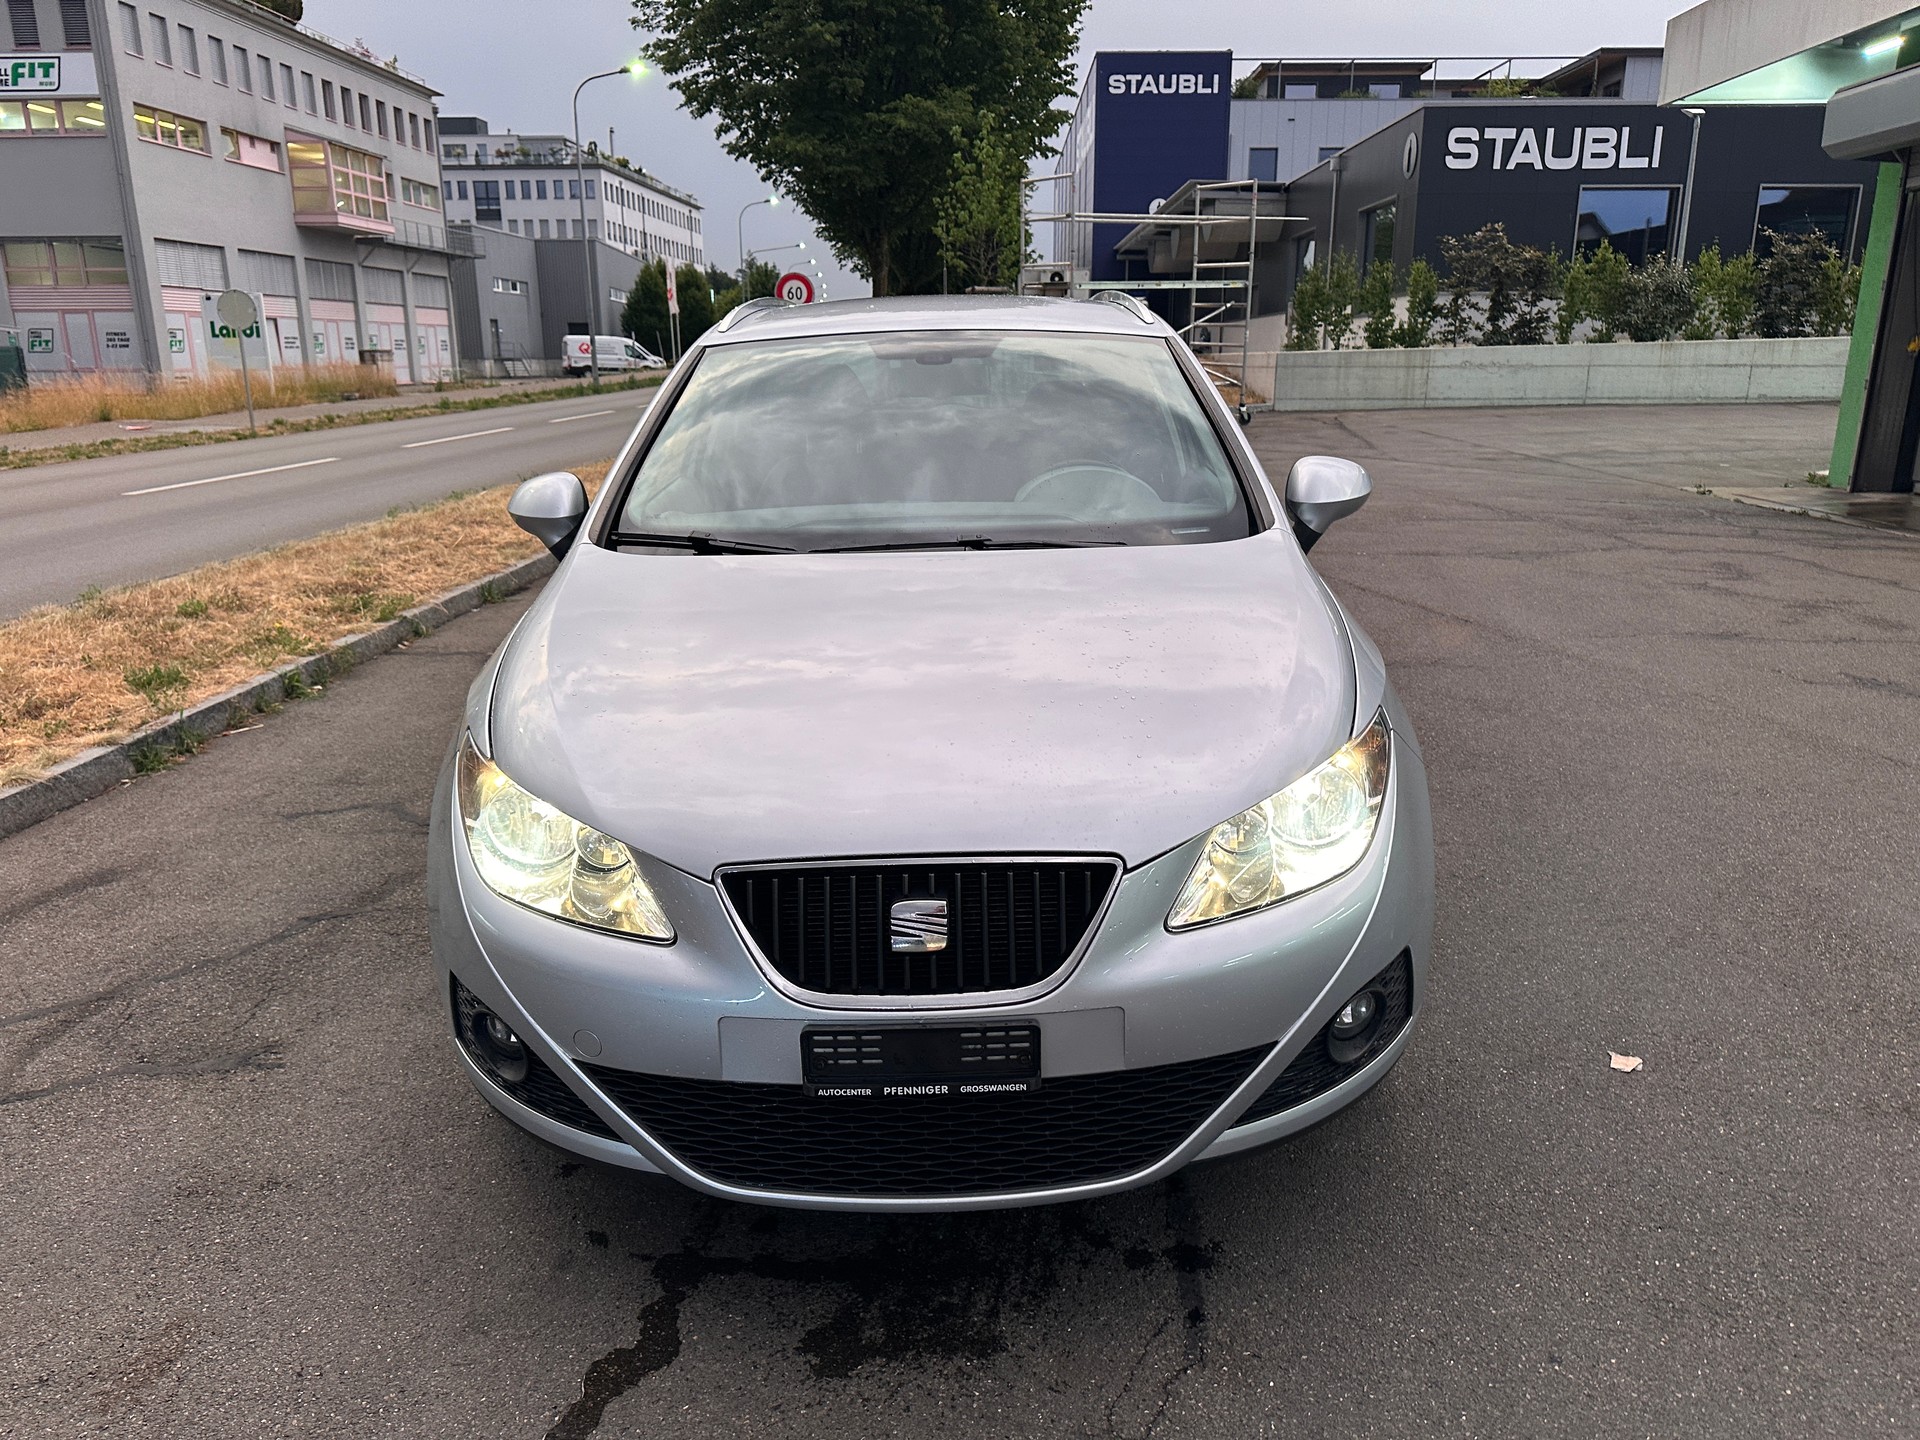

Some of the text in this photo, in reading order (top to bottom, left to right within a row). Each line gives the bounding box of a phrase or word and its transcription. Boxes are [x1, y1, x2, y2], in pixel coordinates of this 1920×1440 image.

[11, 62, 55, 86] FIT
[787, 286, 803, 300] 60
[30, 340, 51, 350] FIT
[883, 1085, 949, 1096] PFENNIGER
[960, 1083, 1027, 1093] GROSSWANGEN
